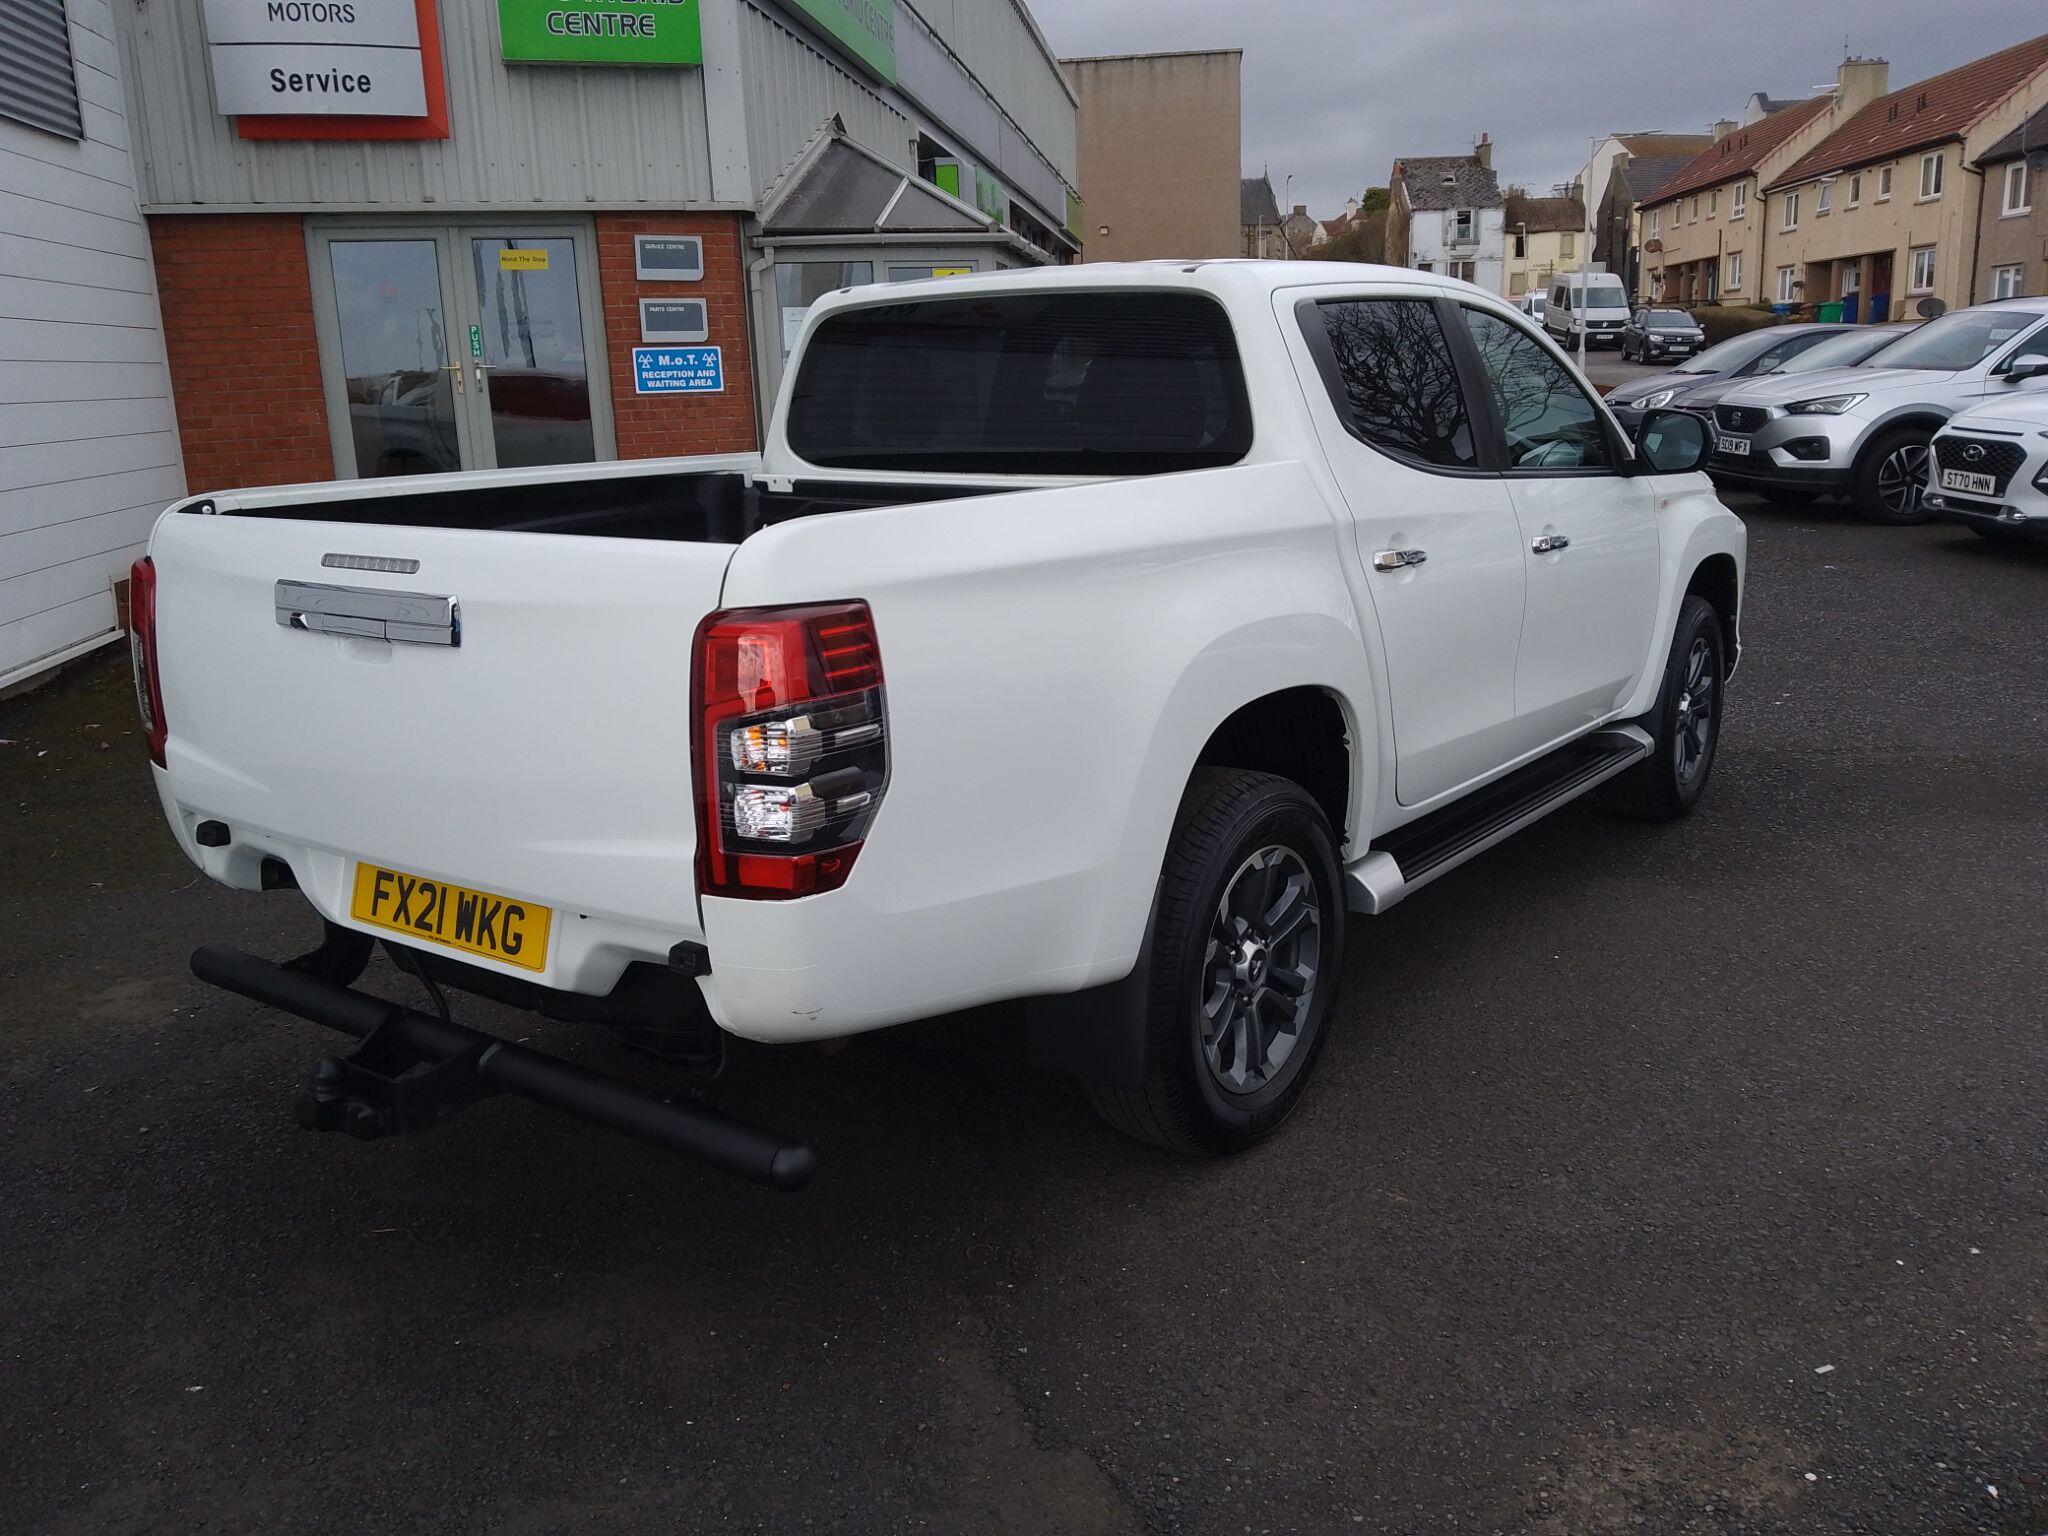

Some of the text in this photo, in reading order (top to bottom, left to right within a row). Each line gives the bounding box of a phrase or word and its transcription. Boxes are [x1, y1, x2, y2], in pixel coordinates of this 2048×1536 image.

[267, 2, 355, 23] MOTORS
[546, 11, 656, 37] CENTRE
[270, 68, 371, 93] Service
[471, 326, 480, 356] PUSH
[658, 354, 698, 366] M.o.T.
[642, 369, 716, 379] RECEPTION AND
[647, 379, 713, 388] WAITING AREA
[1946, 472, 1991, 492] ST70 HNN
[371, 870, 525, 956] FX21 WKG
